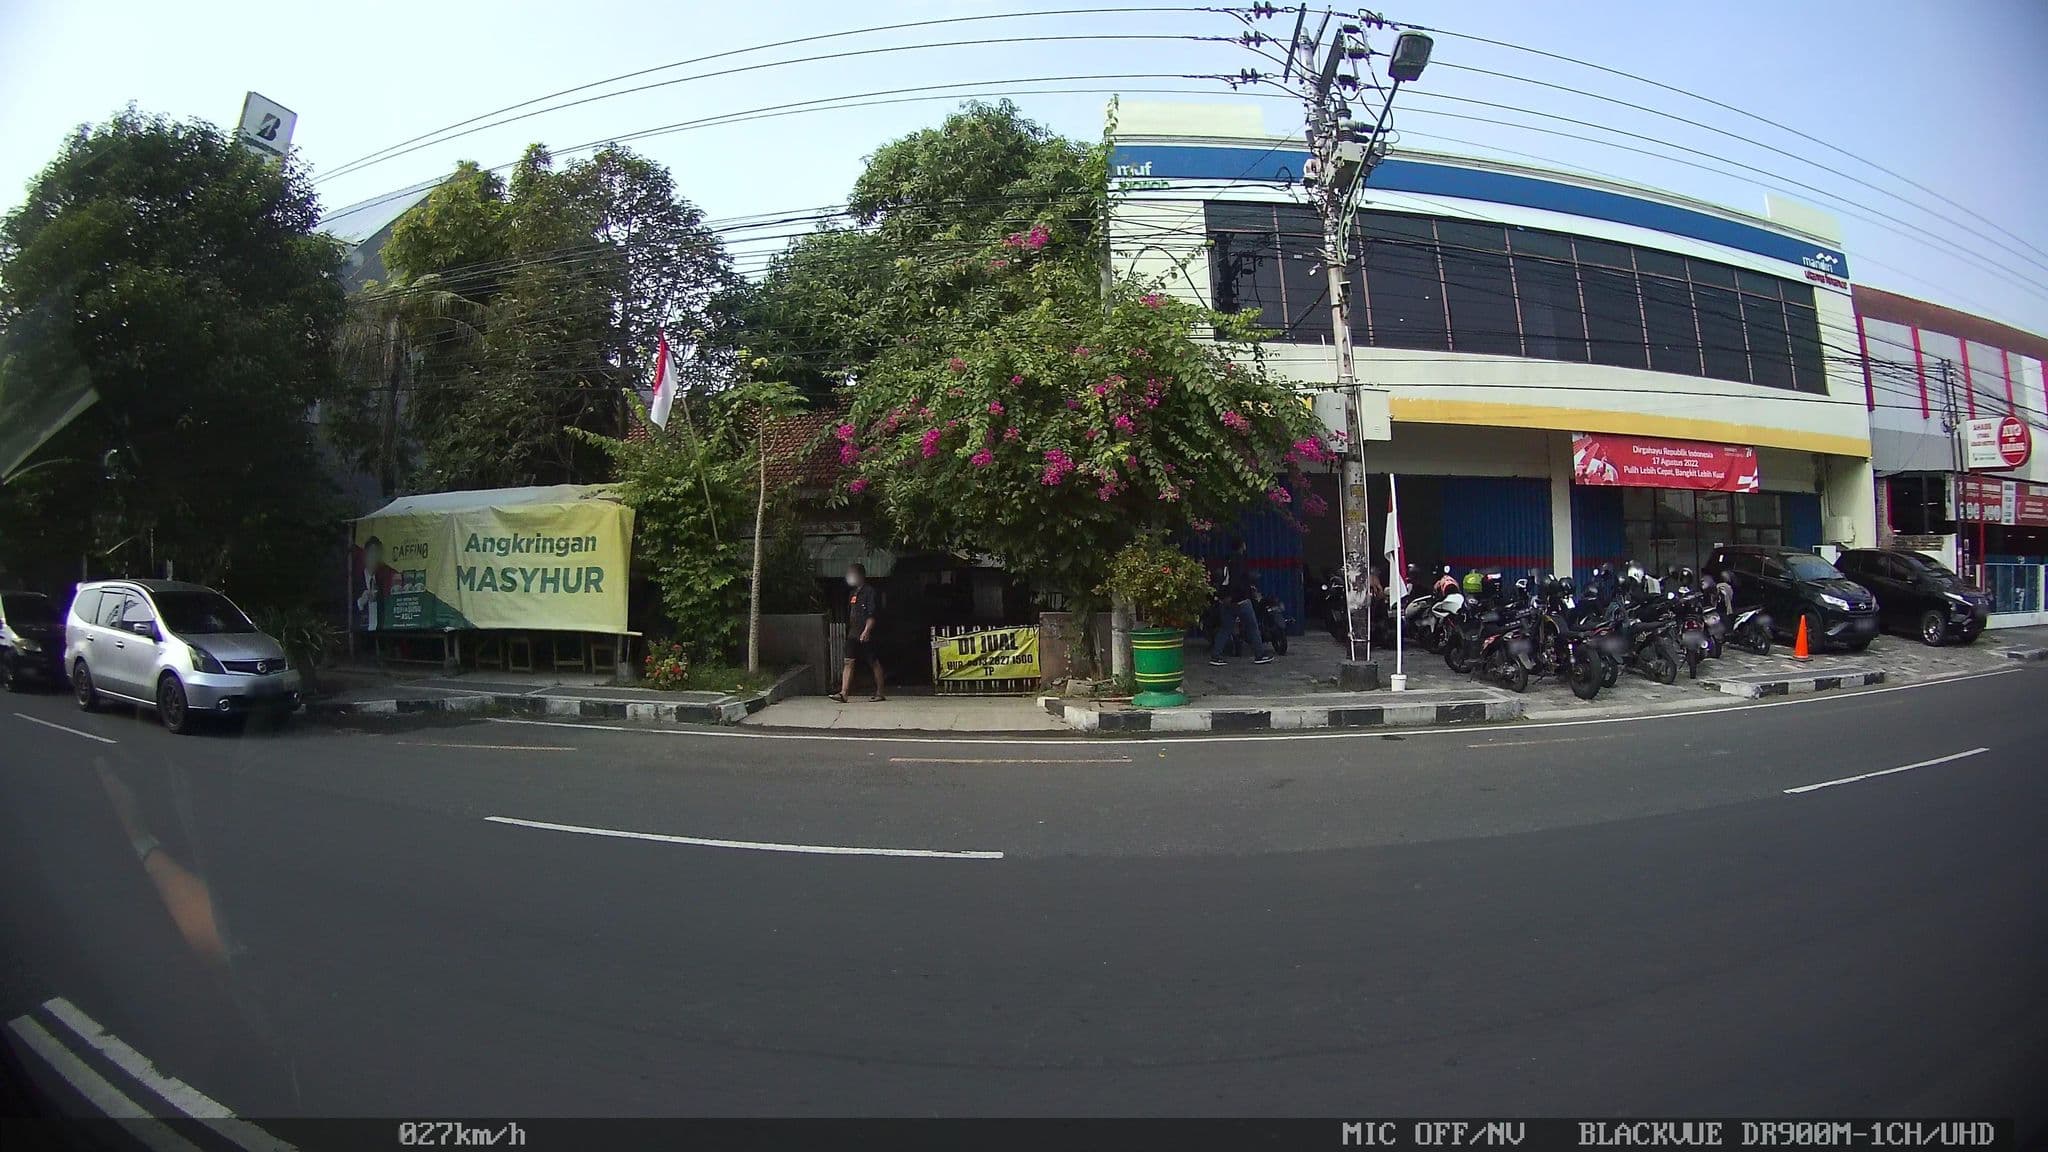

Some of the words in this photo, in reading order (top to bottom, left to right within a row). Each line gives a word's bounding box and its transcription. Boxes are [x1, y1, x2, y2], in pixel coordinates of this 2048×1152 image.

[1663, 447, 1687, 457] Republik
[1687, 449, 1714, 459] Indonesia
[1652, 457, 1660, 465] 17
[1660, 458, 1683, 467] Agustus
[1684, 459, 1699, 468] 2022
[1623, 465, 1639, 474] Pulih
[1640, 467, 1656, 475] Lebih
[1675, 469, 1697, 479] Bangkit
[1697, 470, 1713, 479] Lebih
[1713, 471, 1725, 479] Kuat
[464, 532, 597, 557] Angkringan
[457, 565, 604, 594] MASYHUR
[958, 637, 976, 655] DI
[981, 633, 1018, 653] JUAL
[984, 667, 995, 676] TP
